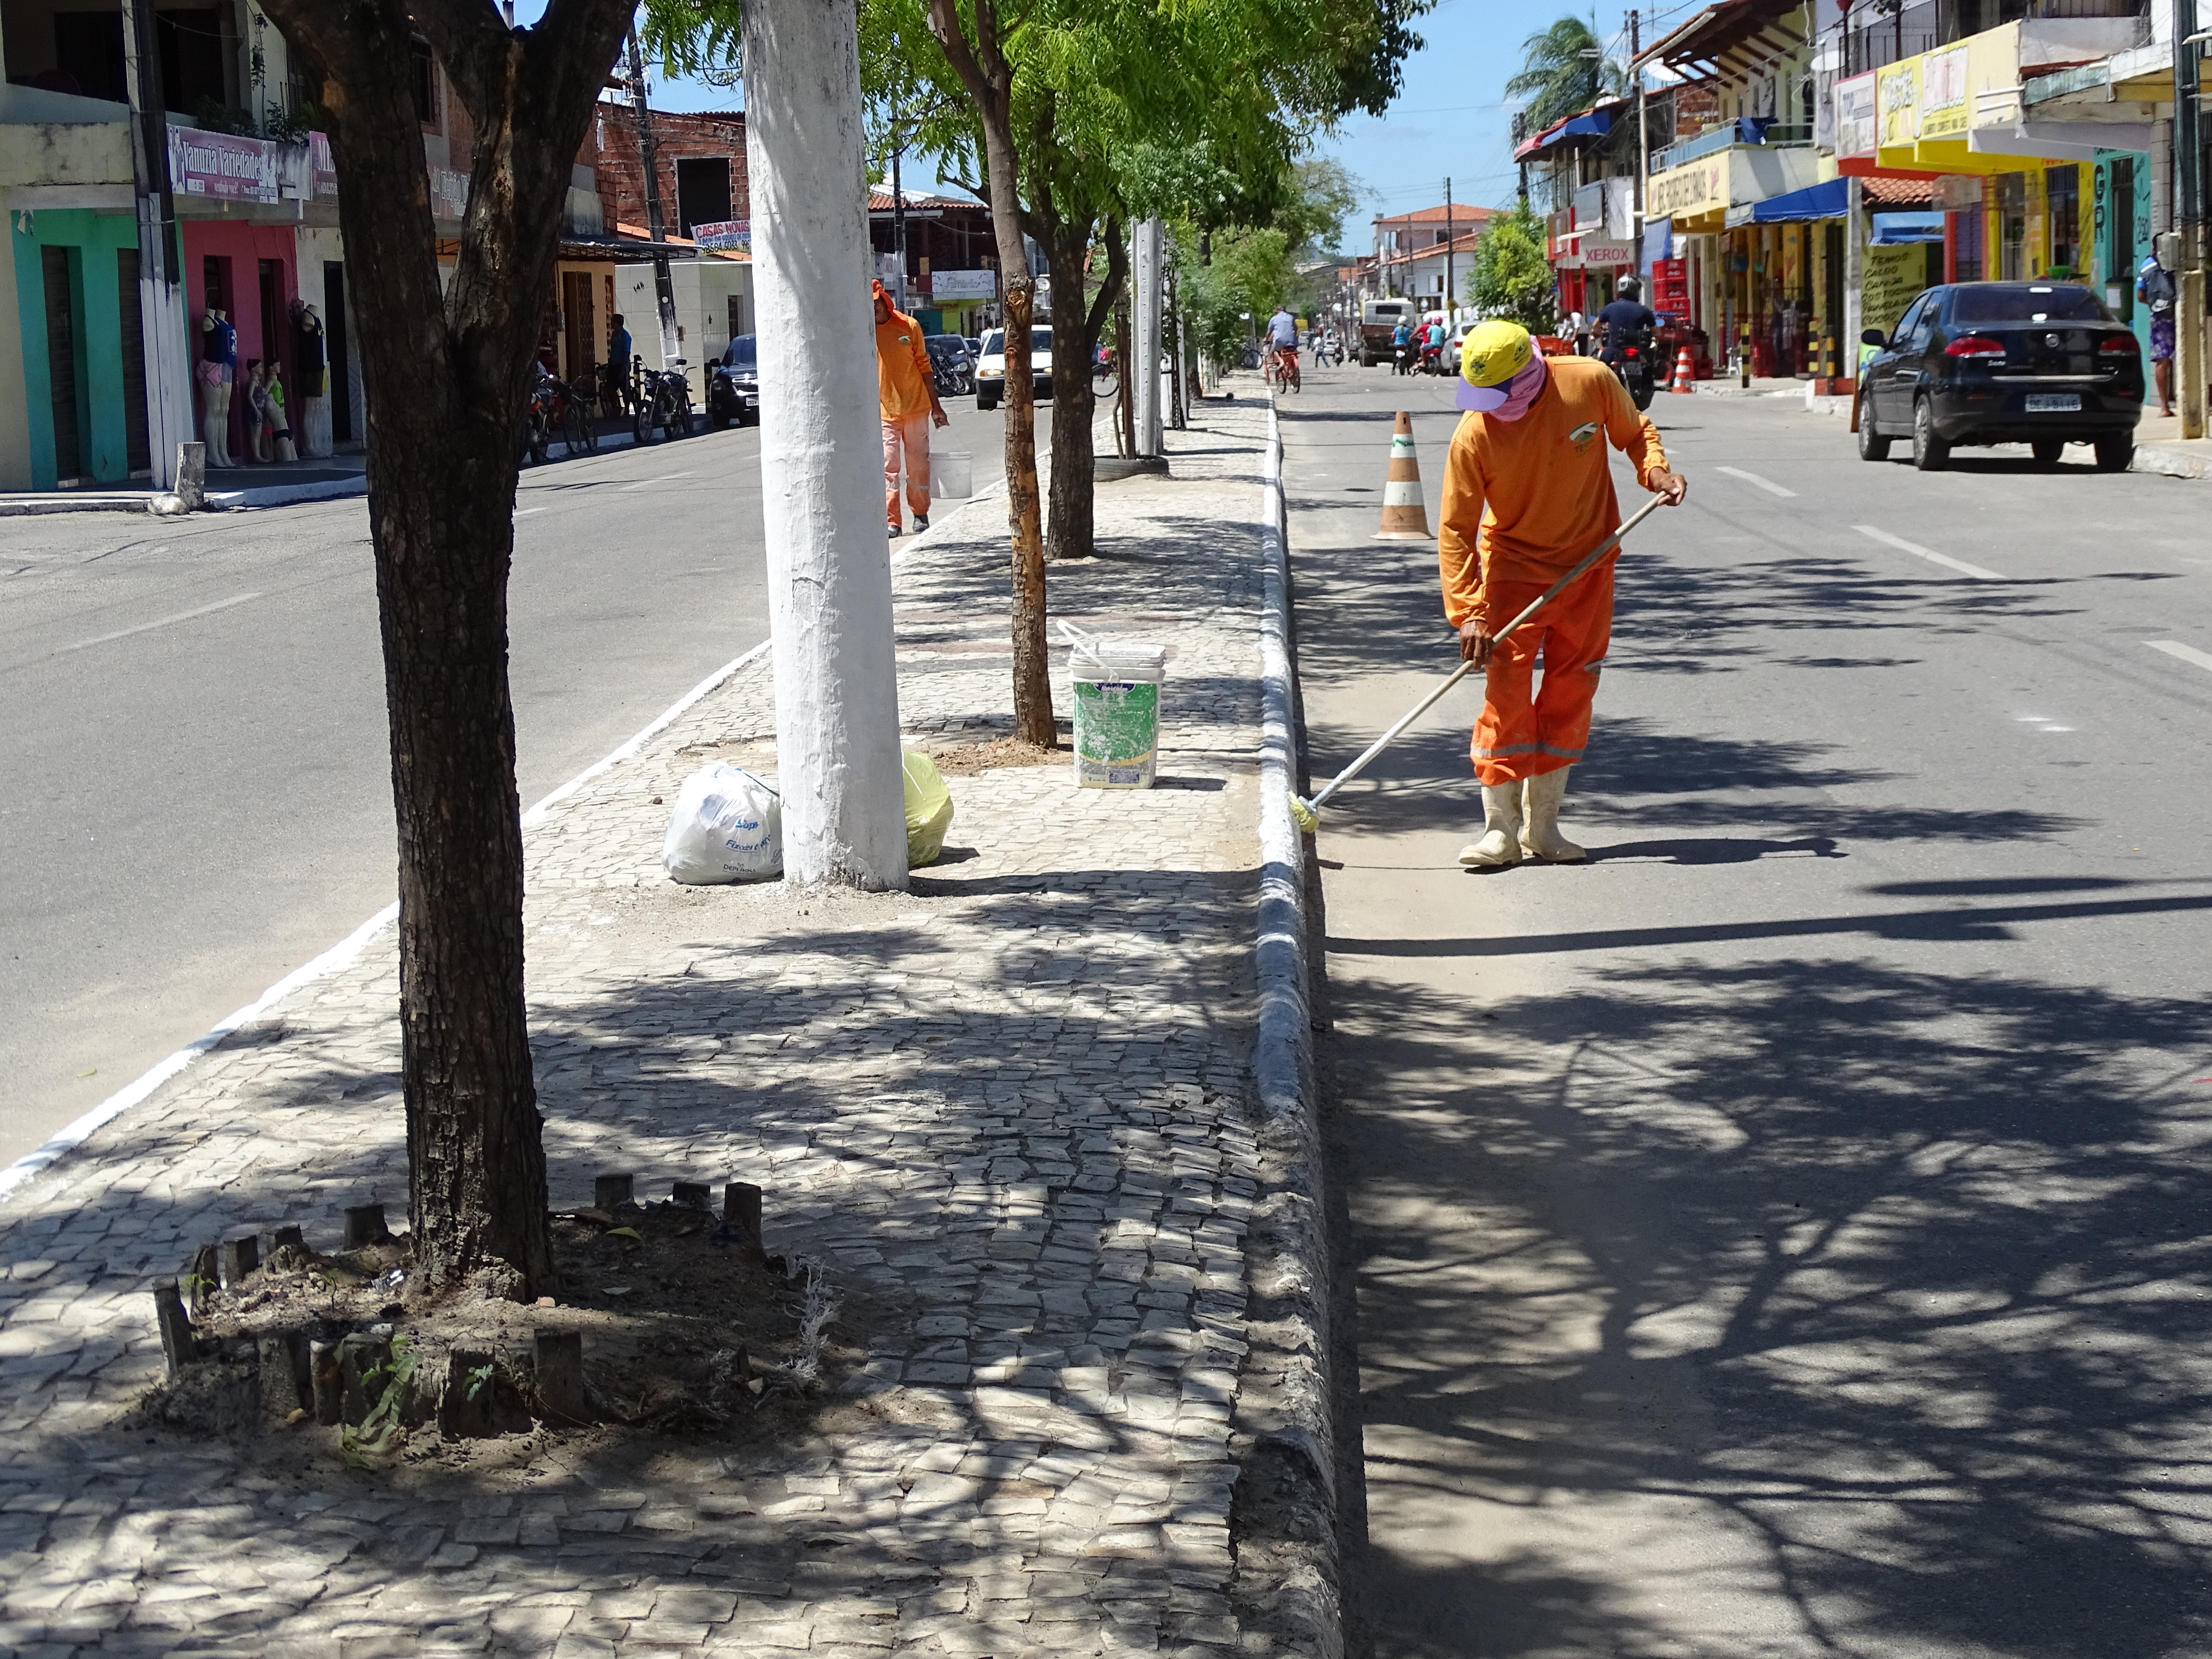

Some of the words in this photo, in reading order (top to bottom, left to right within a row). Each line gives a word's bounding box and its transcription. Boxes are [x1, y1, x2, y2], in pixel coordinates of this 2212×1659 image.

[183, 141, 217, 175] Vanuzia
[218, 146, 263, 181] Variedades
[696, 223, 724, 239] CASAS
[725, 221, 750, 233] NOVAS
[1585, 247, 1629, 261] XEROX
